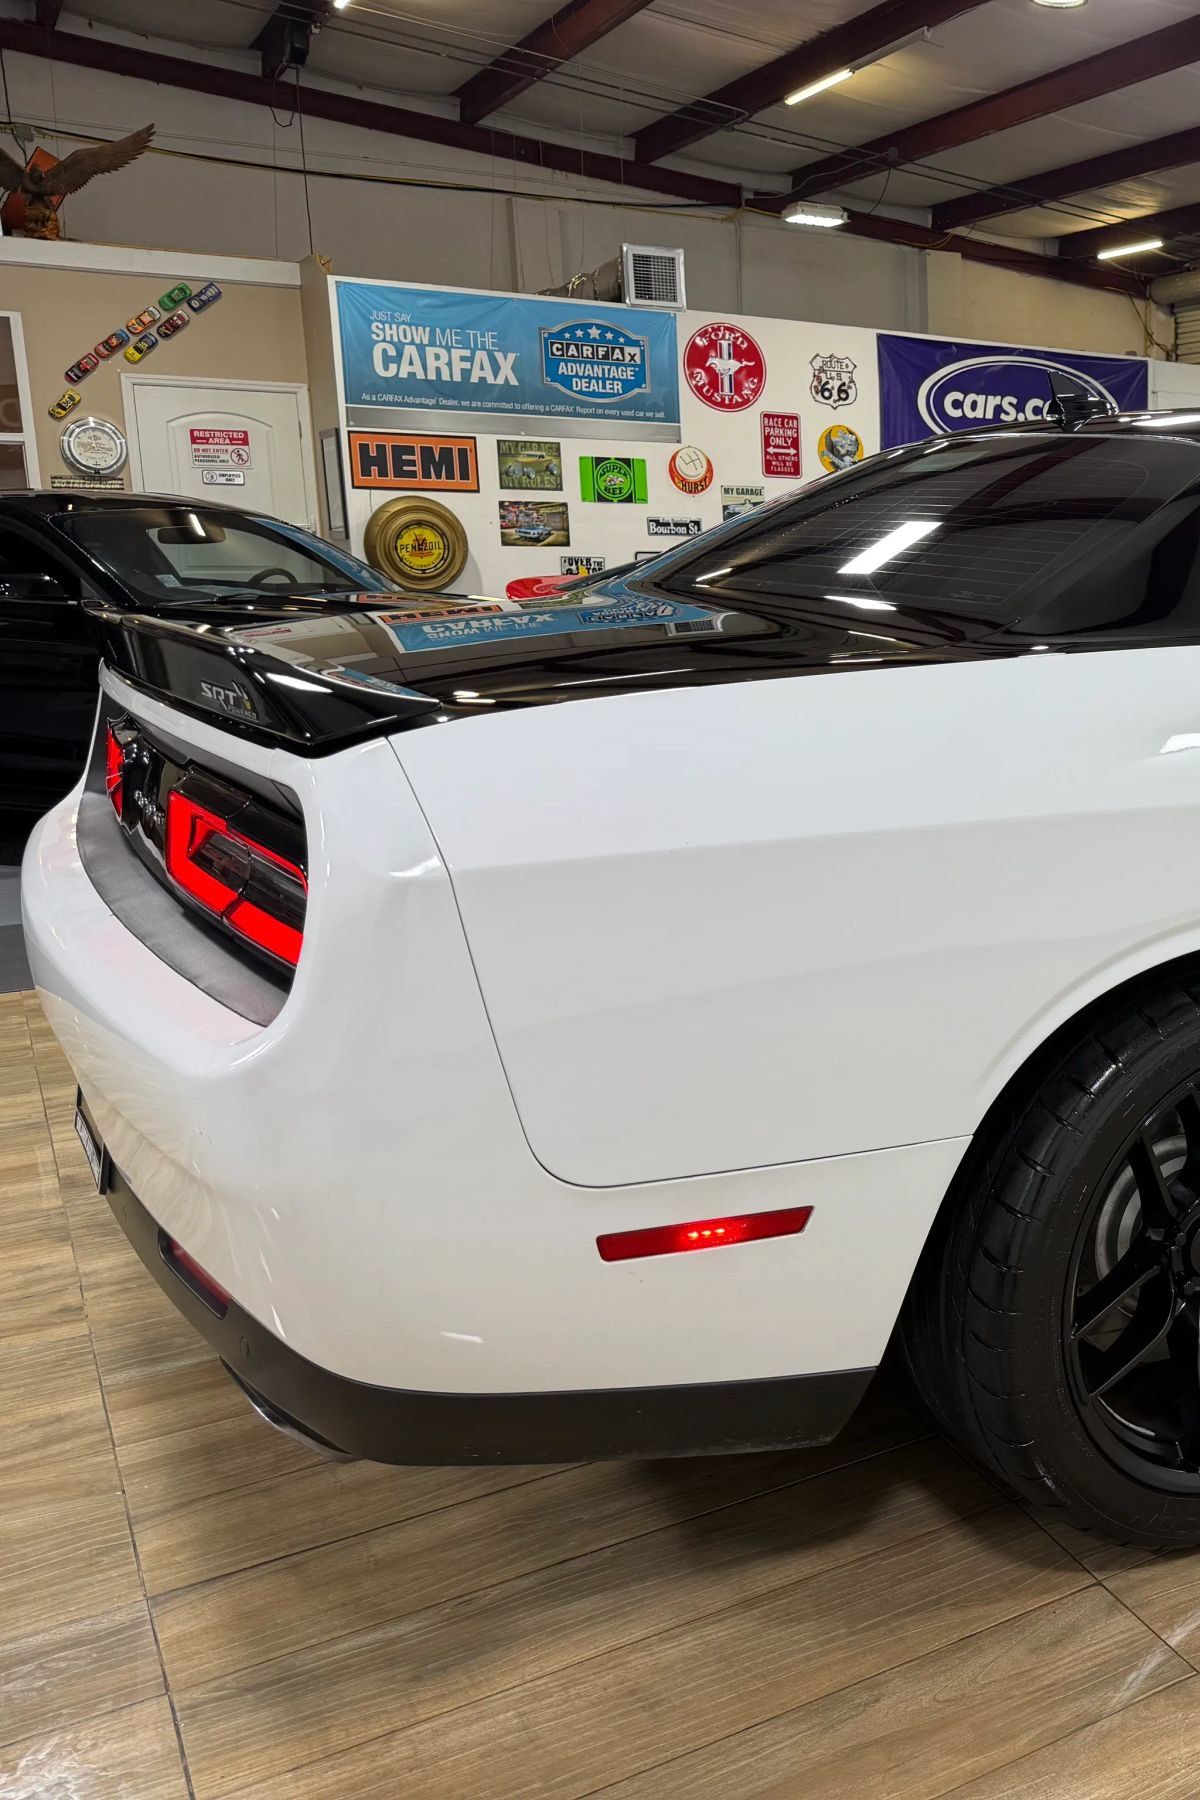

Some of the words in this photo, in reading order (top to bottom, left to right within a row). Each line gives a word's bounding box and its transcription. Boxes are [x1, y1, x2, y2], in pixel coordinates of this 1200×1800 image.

[370, 311, 391, 320] JUST
[394, 313, 411, 322] SAY
[371, 322, 430, 345] SHOW
[435, 327, 463, 347] ME
[466, 330, 499, 350] THE
[696, 330, 748, 349] FORD
[551, 343, 638, 363] CARFAX
[372, 342, 520, 386] CARFAX
[558, 362, 635, 380] ADVANTAGE
[822, 360, 845, 369] ROUTE
[572, 378, 623, 393] DEALER
[692, 369, 758, 404] MUSTANG
[820, 381, 850, 402] 66
[361, 392, 371, 400] As
[377, 393, 404, 403] CARFAX
[482, 401, 514, 409] committed
[514, 402, 521, 410] to
[521, 403, 545, 413] offering
[575, 406, 596, 415] Report
[604, 409, 620, 417] every
[621, 409, 635, 417] used
[943, 391, 1052, 422] cars.c
[764, 417, 783, 427] RACE
[784, 418, 798, 428] CAR
[193, 430, 245, 439] RESTRICTED
[764, 426, 798, 438] PARKING
[500, 440, 517, 454] MY
[518, 442, 560, 456] GARAGE
[769, 436, 793, 446] ONLY
[358, 442, 471, 482] HEMI
[599, 465, 628, 480] SUPER
[501, 477, 520, 488] MY
[681, 475, 708, 494] HURST
[604, 485, 625, 496] BEE
[723, 487, 734, 495] MY
[736, 487, 763, 497] GARAGE
[650, 521, 687, 534] Bourbon
[689, 522, 701, 535] St.
[567, 557, 592, 567] OVER
[200, 682, 237, 710] SRT
